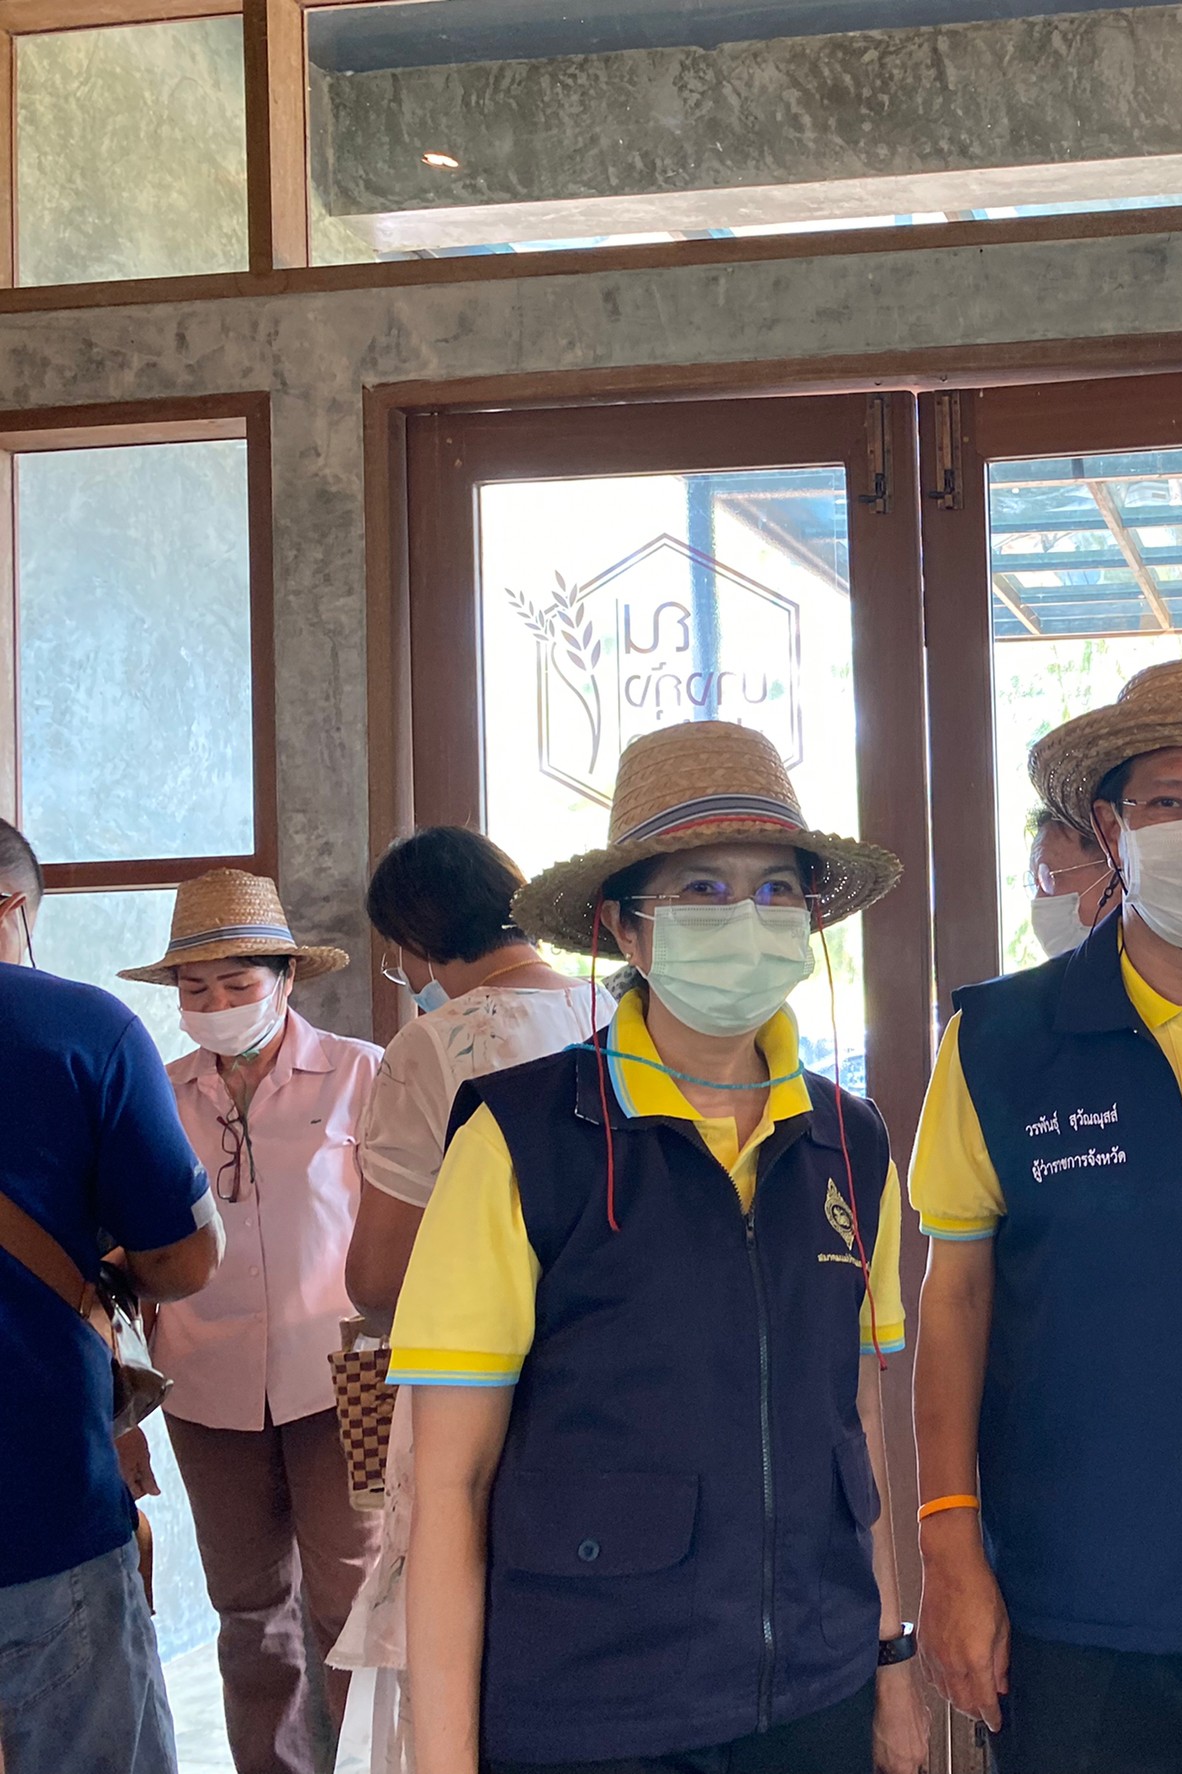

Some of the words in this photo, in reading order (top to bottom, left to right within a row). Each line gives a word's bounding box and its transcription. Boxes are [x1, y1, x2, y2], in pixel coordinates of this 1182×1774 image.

[1031, 1145, 1127, 1183] ผู้ว่าราชการจังหวัด
